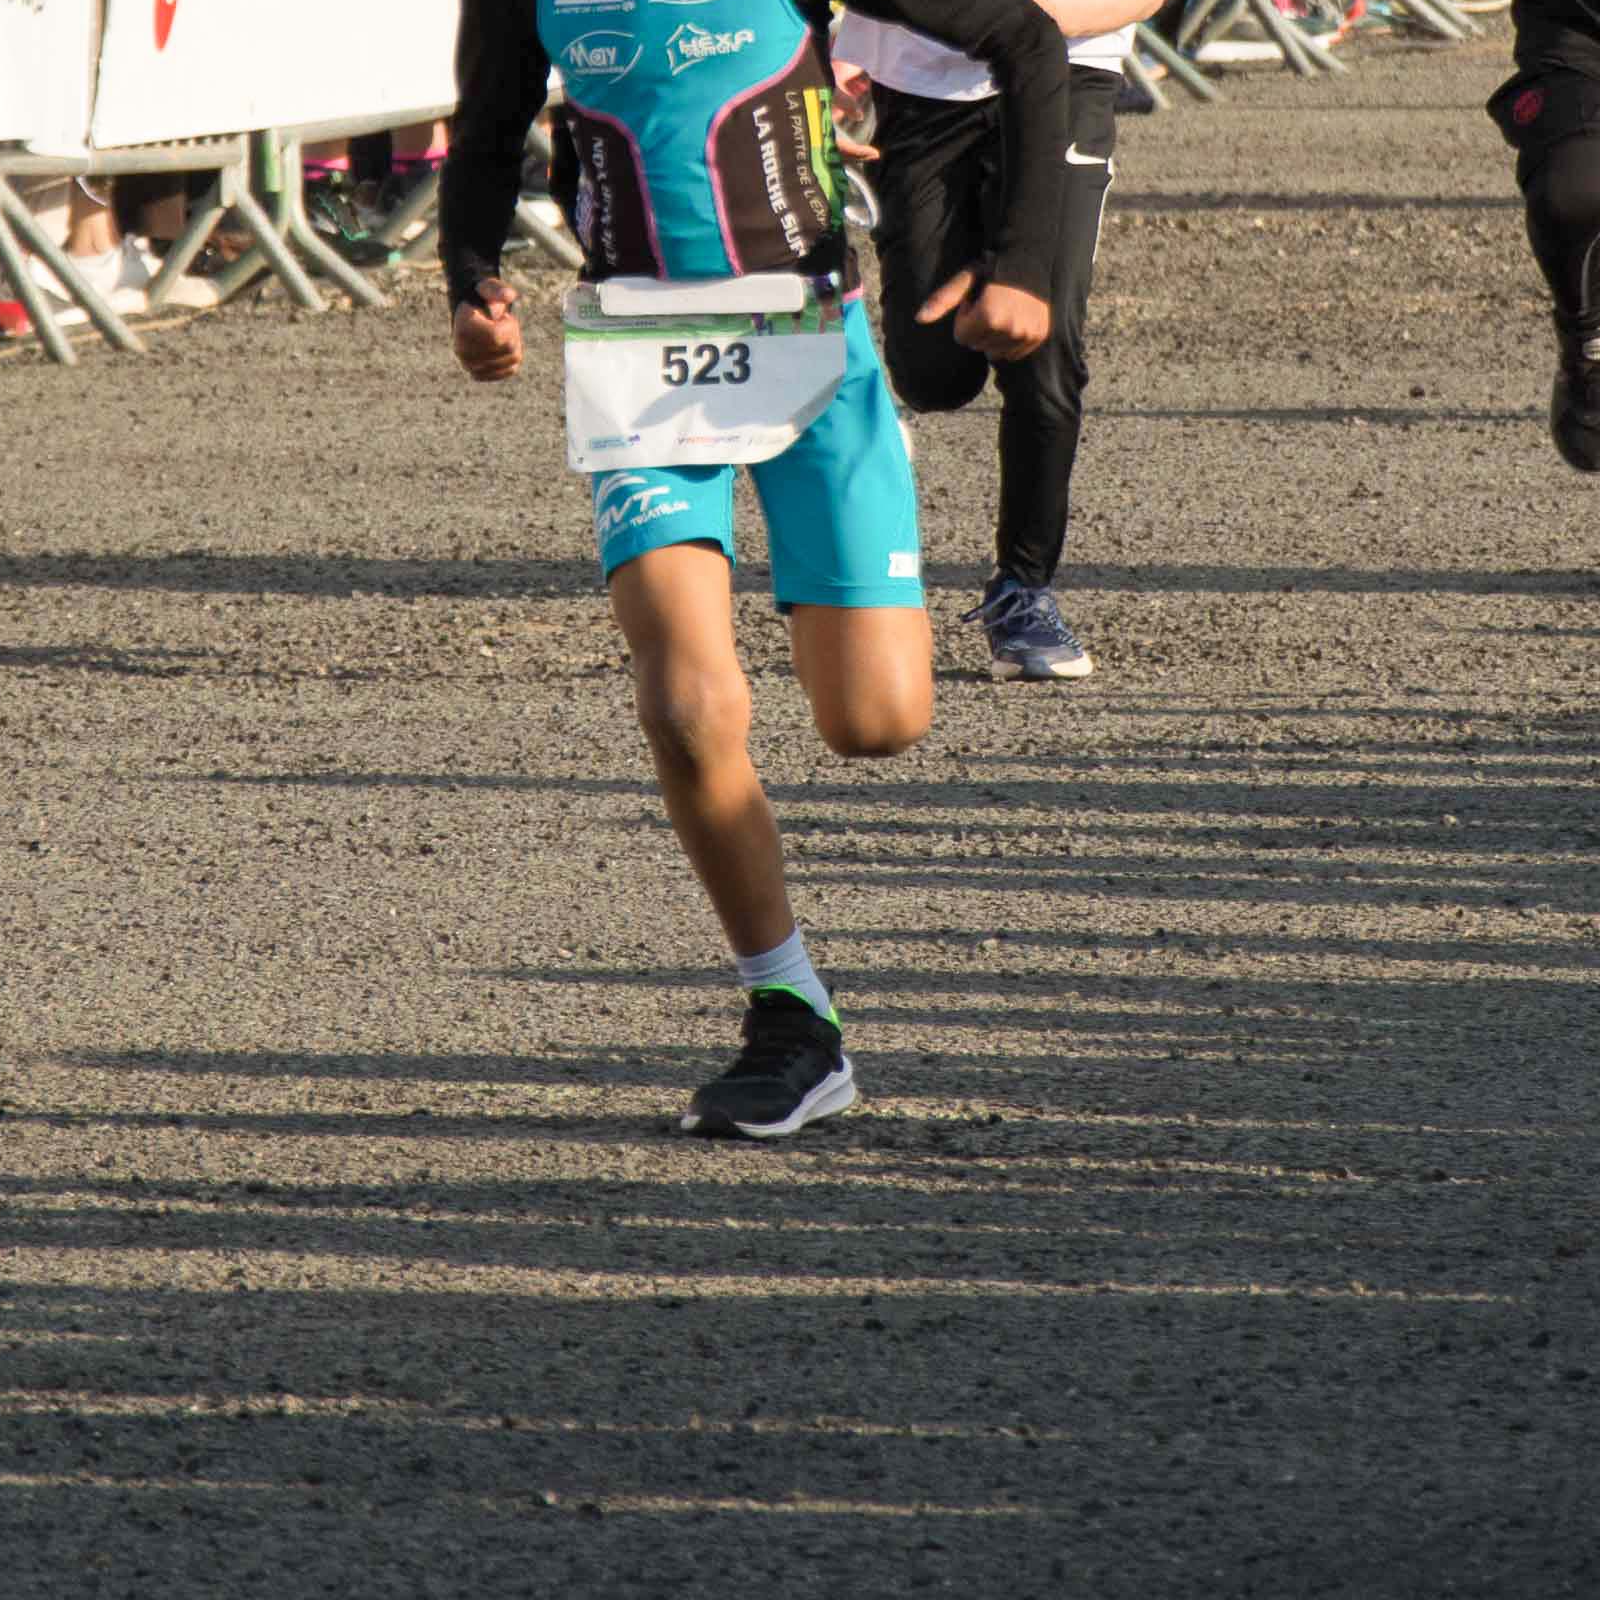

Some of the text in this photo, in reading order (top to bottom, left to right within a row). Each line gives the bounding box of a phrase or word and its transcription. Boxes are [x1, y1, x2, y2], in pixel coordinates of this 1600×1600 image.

[785, 91, 799, 111] LA
[753, 106, 773, 140] LA
[789, 115, 807, 161] PATTE
[760, 141, 788, 214] ROCHE
[797, 166, 812, 185] DE
[662, 342, 751, 386] 523
